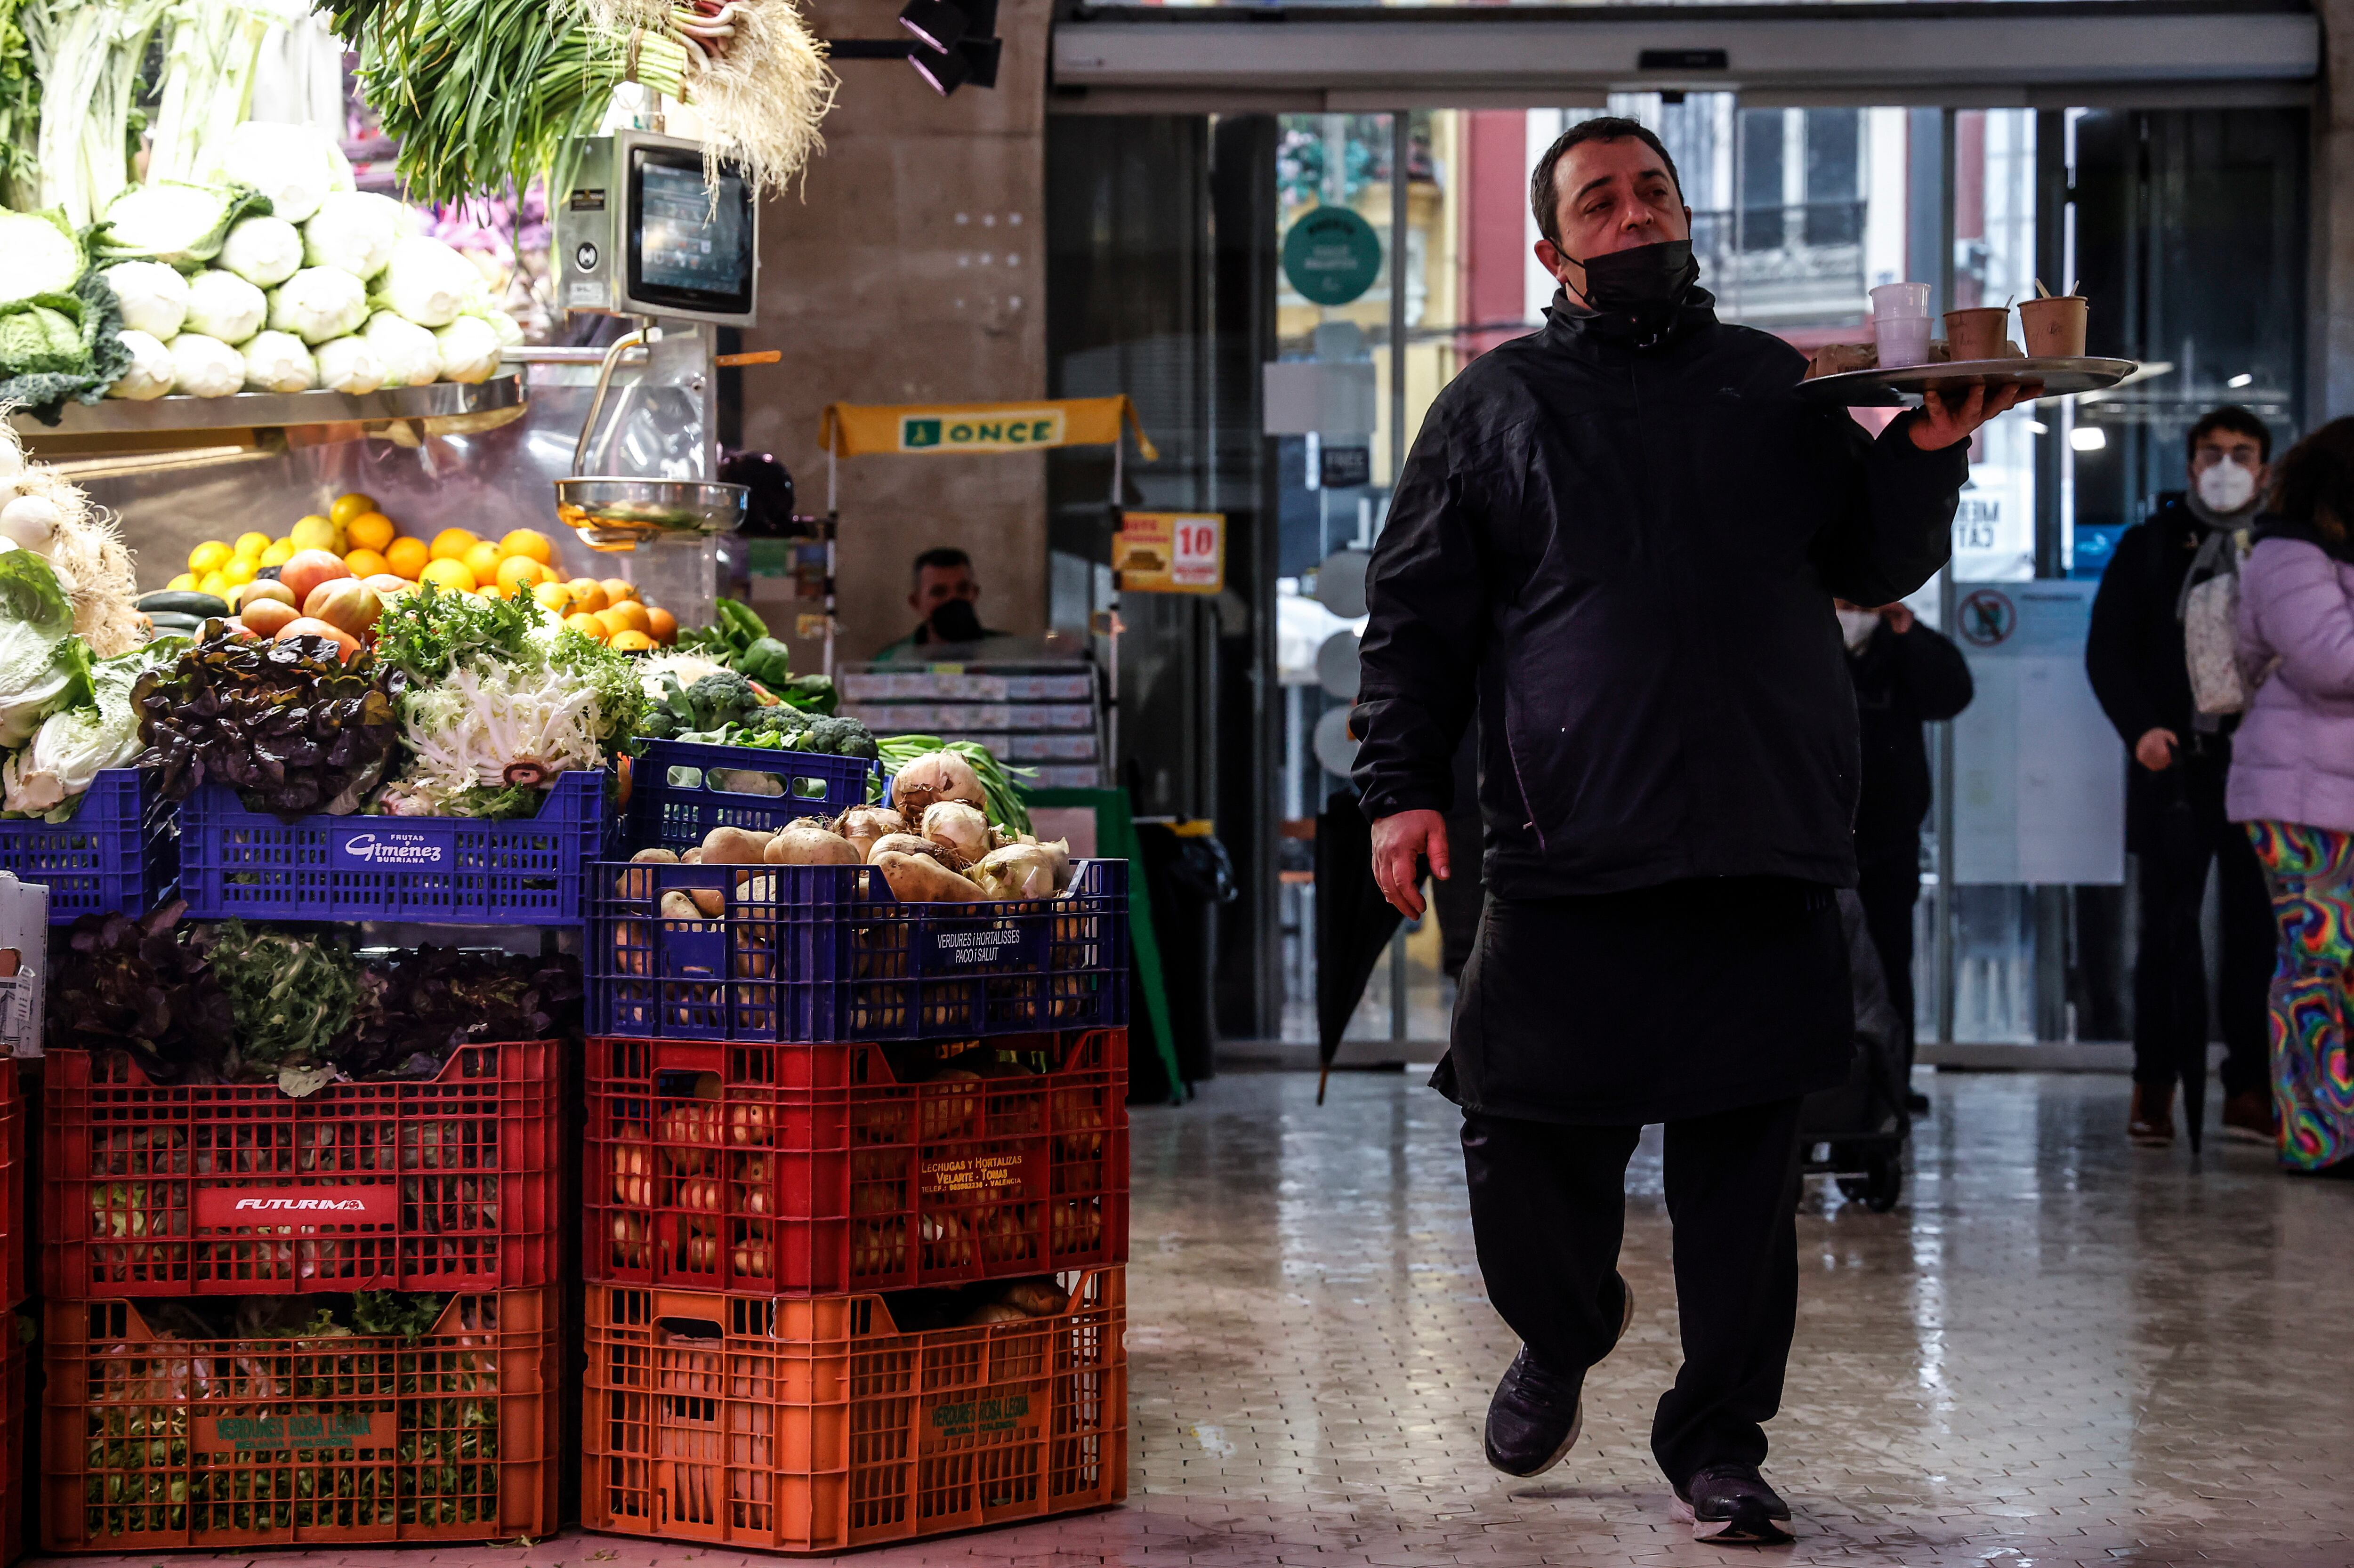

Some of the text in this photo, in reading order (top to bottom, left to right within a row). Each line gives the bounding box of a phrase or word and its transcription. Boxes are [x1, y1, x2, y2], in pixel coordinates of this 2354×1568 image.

[949, 421, 1052, 442] ONCE
[1180, 526, 1213, 555] 10
[937, 933, 972, 949] VERDURES
[976, 929, 1020, 946] HORTALISSES
[956, 949, 973, 963] PACO
[977, 947, 999, 962] SALUT
